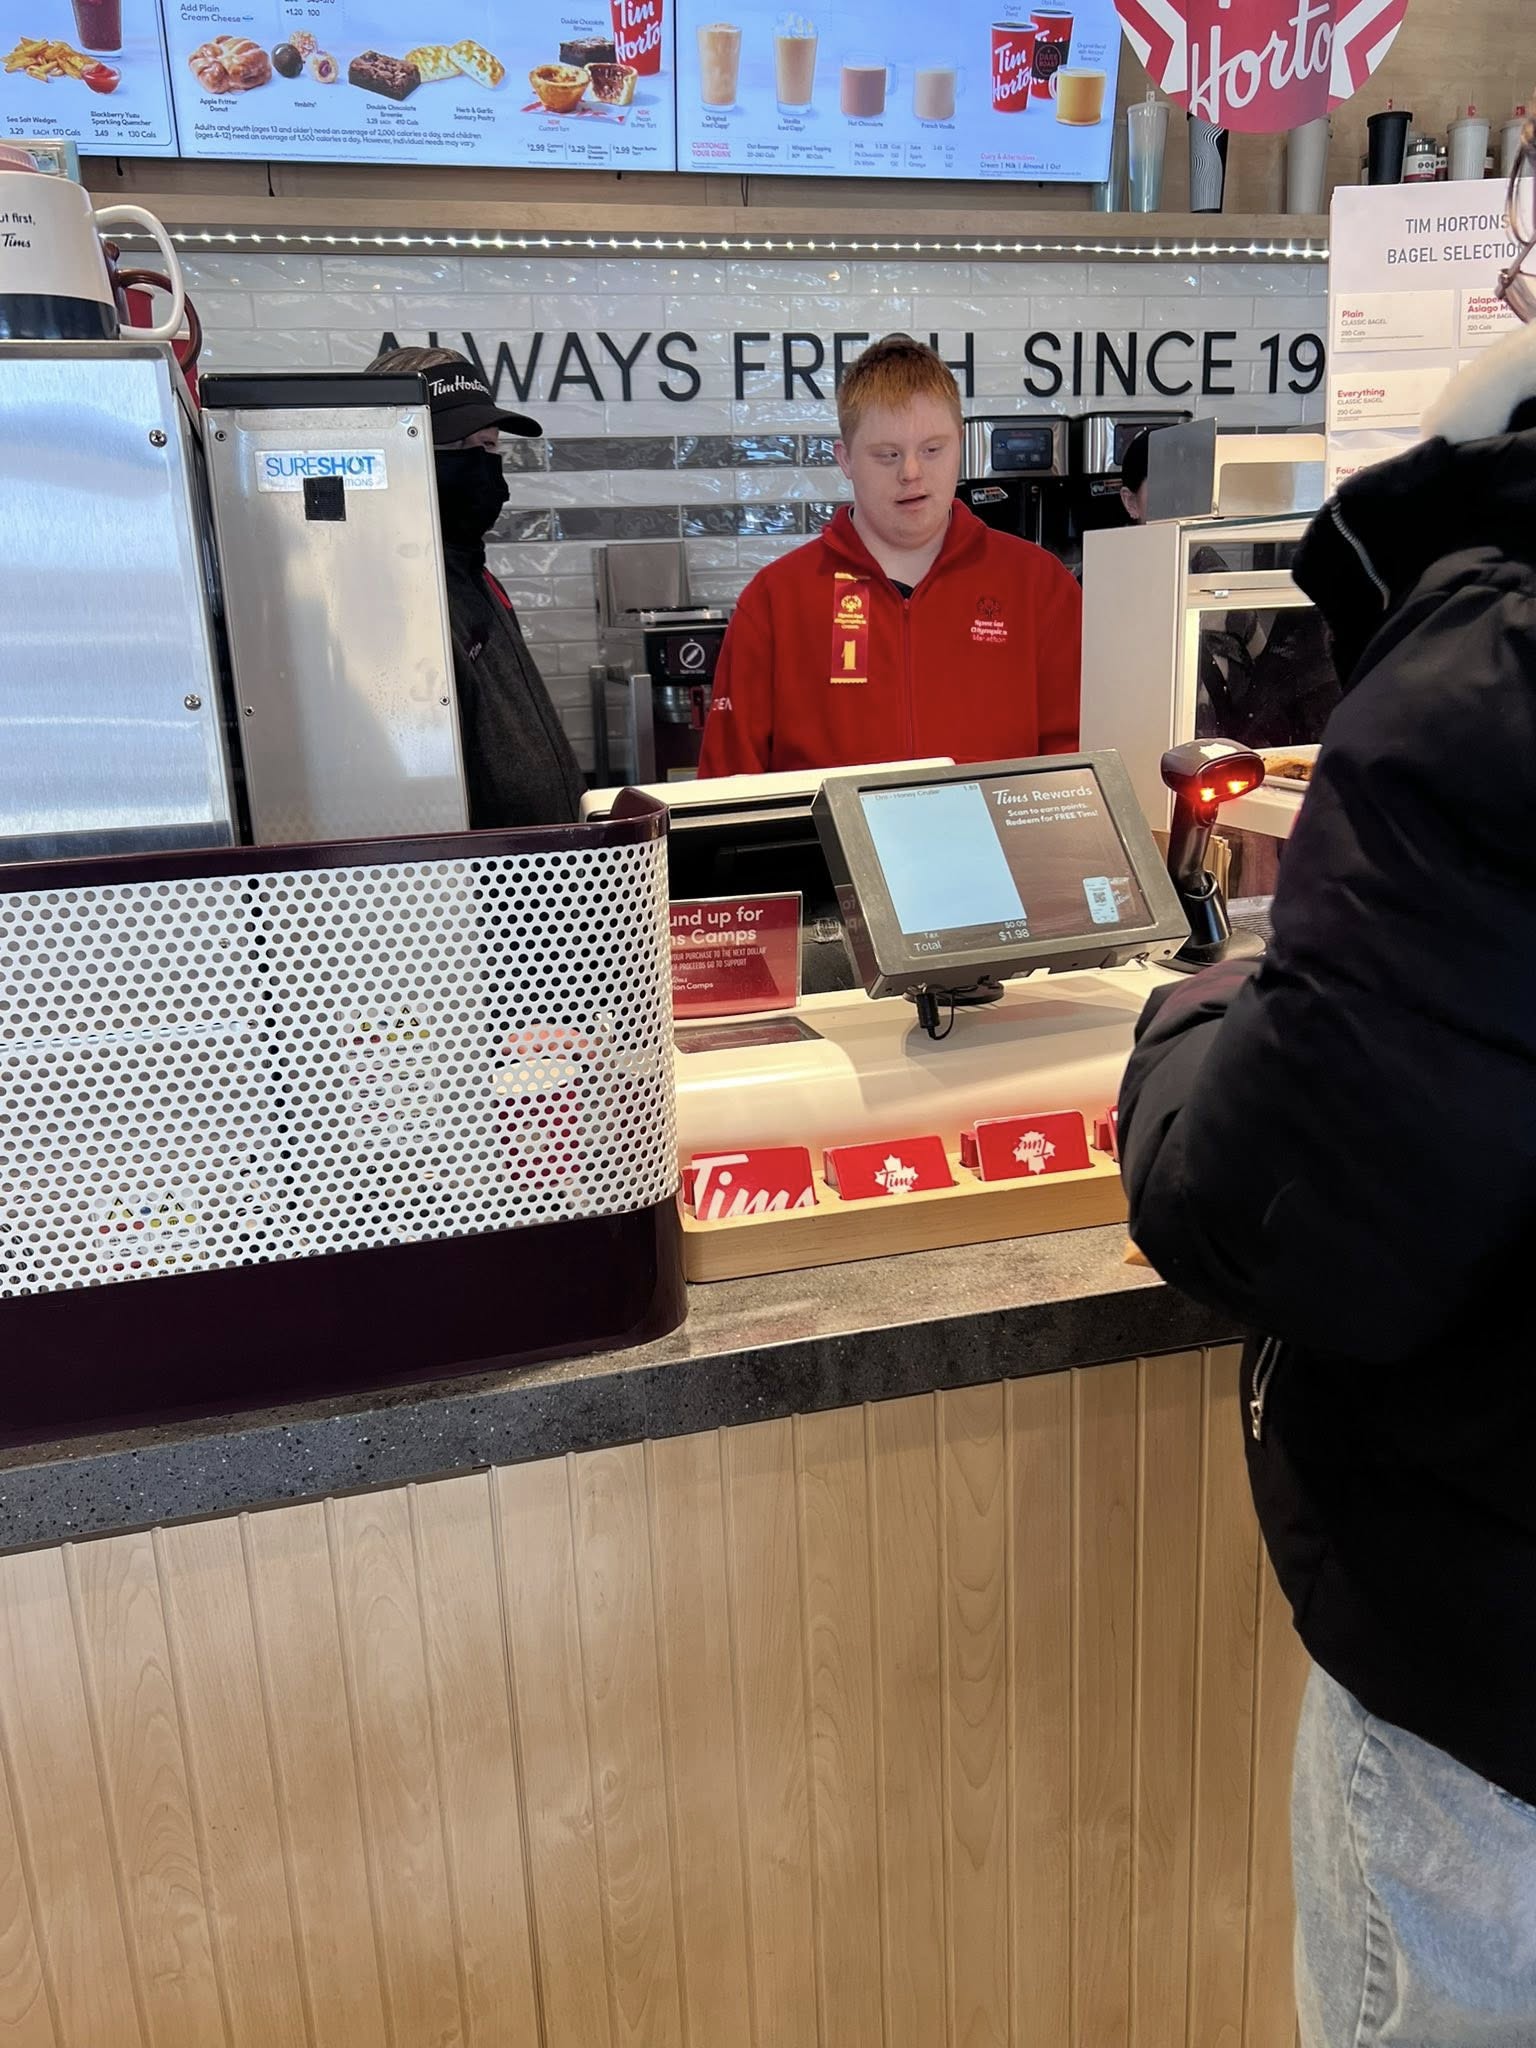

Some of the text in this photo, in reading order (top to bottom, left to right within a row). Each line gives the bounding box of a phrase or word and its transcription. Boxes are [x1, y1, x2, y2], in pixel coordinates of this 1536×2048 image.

[180, 4, 220, 12] Add Plain
[181, 13, 210, 22] Cream
[211, 14, 241, 23] Cheese
[995, 41, 1026, 73] Tim
[200, 98, 217, 106] Apple
[90, 111, 124, 119] Blackberry
[91, 118, 121, 126] Sparkling
[9, 127, 24, 135] 3.29
[94, 129, 109, 137] 3.49
[252, 125, 270, 133] (ages
[195, 132, 214, 140] (ages
[297, 134, 314, 142] 1,500
[0, 213, 9, 223] ut
[1405, 214, 1510, 234] TIM HORTONS
[1, 233, 31, 248] Tims
[1387, 247, 1438, 264] BAGEL
[1468, 296, 1503, 305] Jalape
[1342, 310, 1364, 318] Plain
[1468, 305, 1498, 313] Asiago
[377, 331, 1327, 401] WAYS FREH SINCE 19
[429, 378, 455, 396] Tim
[1337, 388, 1385, 398] Everything
[266, 456, 375, 477] SURESHOT
[1336, 466, 1355, 474] Four
[974, 619, 1004, 628] Special
[970, 626, 1008, 636] Olympics
[841, 640, 856, 670] 1
[992, 785, 1093, 805] Tims Rewards
[1007, 809, 1030, 817] Scan
[1060, 803, 1088, 812] points.
[1005, 818, 1040, 827] Redeem
[1054, 812, 1077, 821] FREE
[1077, 810, 1098, 818] Tims!
[670, 906, 764, 928] und up for
[691, 928, 757, 946] Camps
[998, 929, 1030, 942] $1.98
[913, 941, 942, 953] Total
[685, 950, 713, 960] PURCHASE
[746, 946, 767, 956] DOLLAR
[679, 962, 706, 970] PROCEEDS
[723, 958, 747, 967] SUPPORT
[686, 982, 714, 990] Camps
[880, 1170, 916, 1188] Tims
